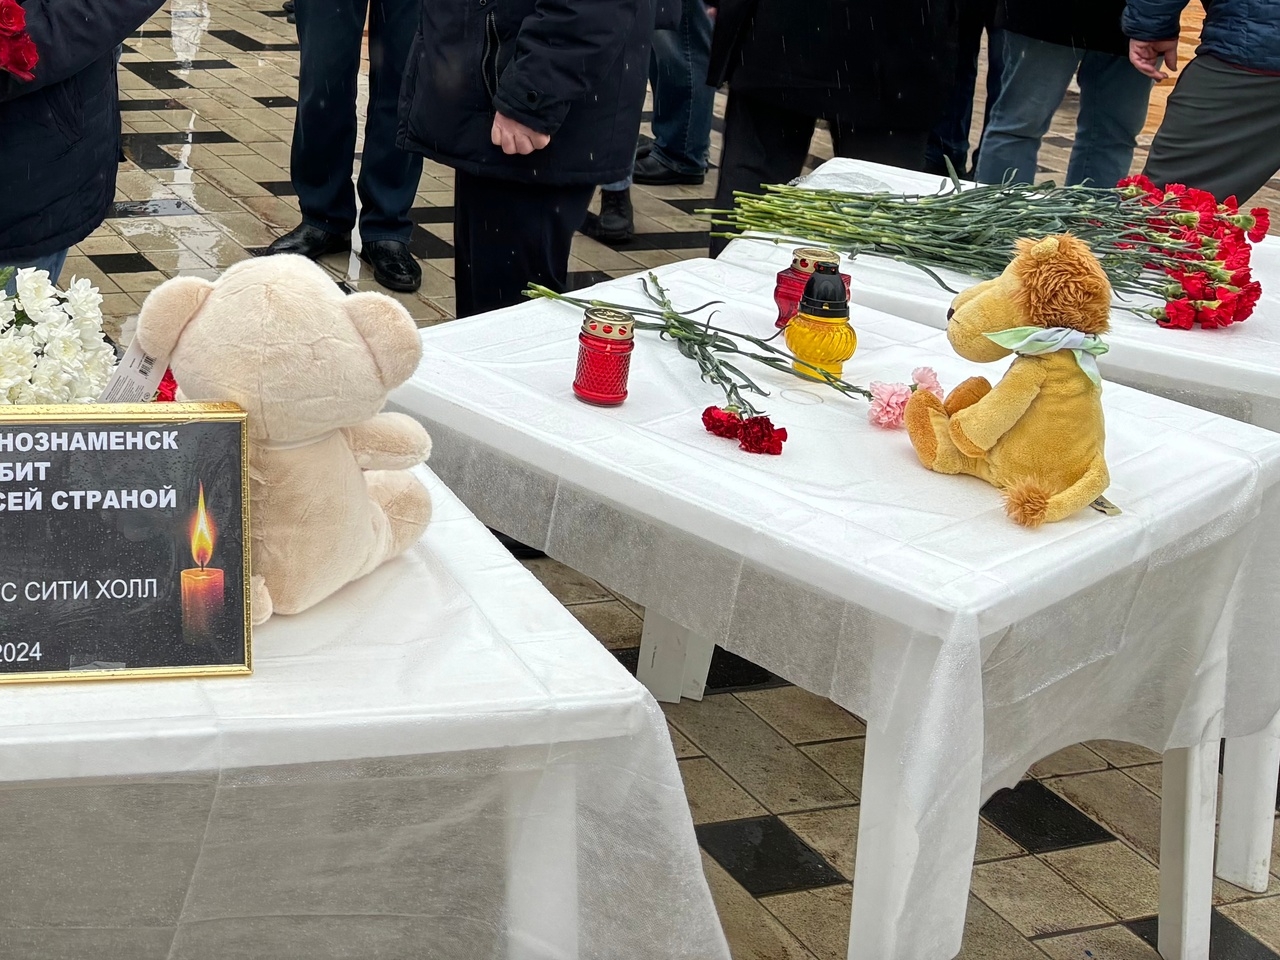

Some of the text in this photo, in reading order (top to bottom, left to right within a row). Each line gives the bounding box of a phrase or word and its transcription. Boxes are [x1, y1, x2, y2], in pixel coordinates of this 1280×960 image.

[51, 484, 177, 510] СТРАНОЙ
[24, 579, 89, 603] СИТИ
[95, 578, 158, 600] ХОЛЛ
